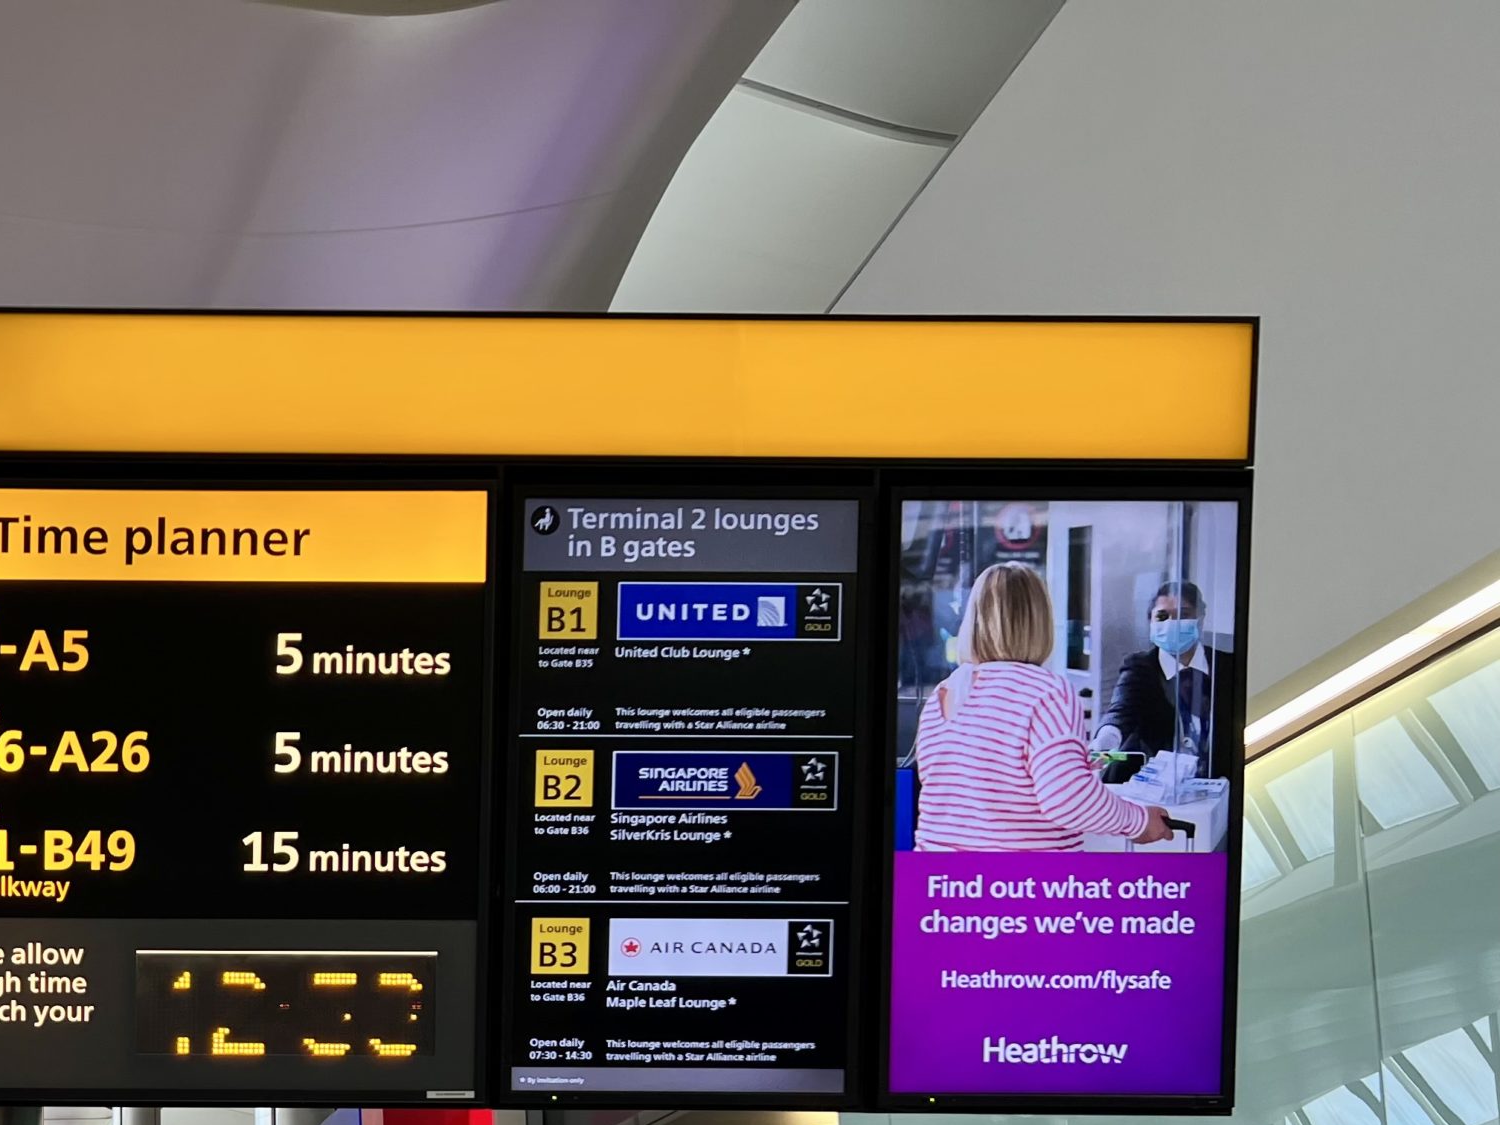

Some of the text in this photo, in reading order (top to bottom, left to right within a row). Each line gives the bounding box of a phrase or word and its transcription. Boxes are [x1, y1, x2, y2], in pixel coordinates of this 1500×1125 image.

[567, 507, 818, 535] Terminal 2 lounges
[125, 517, 310, 565] planner
[569, 535, 695, 562] in B gates
[548, 587, 591, 600] Lounge
[637, 603, 750, 620] UNITED
[547, 607, 586, 632] B1
[804, 623, 831, 631] GOLD
[276, 633, 303, 675] 5
[313, 645, 451, 675] minutes
[539, 646, 576, 655] Located
[615, 646, 740, 661] United Club Lounge
[538, 659, 593, 668] to Gate B35
[537, 707, 593, 719] Open daily
[537, 720, 600, 730] 06:30 21:00
[274, 732, 301, 773] 5
[311, 744, 449, 774] minutes
[544, 756, 587, 768] Lounge
[639, 768, 728, 779] SINGAPORE
[543, 774, 581, 800] B2
[658, 780, 728, 791] AIRLINES
[610, 812, 728, 826] Singapore Airlines
[610, 829, 721, 843] SilverKris Lounge
[242, 831, 299, 872] 15
[309, 843, 446, 872] minutes
[928, 874, 1191, 899] Find out what other
[540, 924, 583, 936] Lounge
[920, 909, 1195, 939] changes we've made
[11, 942, 84, 965] allow
[539, 942, 577, 967] B3
[650, 942, 777, 954] AIR CANADA
[27, 971, 87, 994] time
[606, 980, 676, 991] Air Canada
[941, 969, 1172, 994] Heathrow.com/flysafe
[606, 996, 727, 1011] Maple Leaf Lounge
[33, 1005, 94, 1027] your
[529, 1038, 585, 1049] Open daily
[983, 1035, 1128, 1063] Heathrow
[529, 1051, 592, 1060] 07:30 14:30
